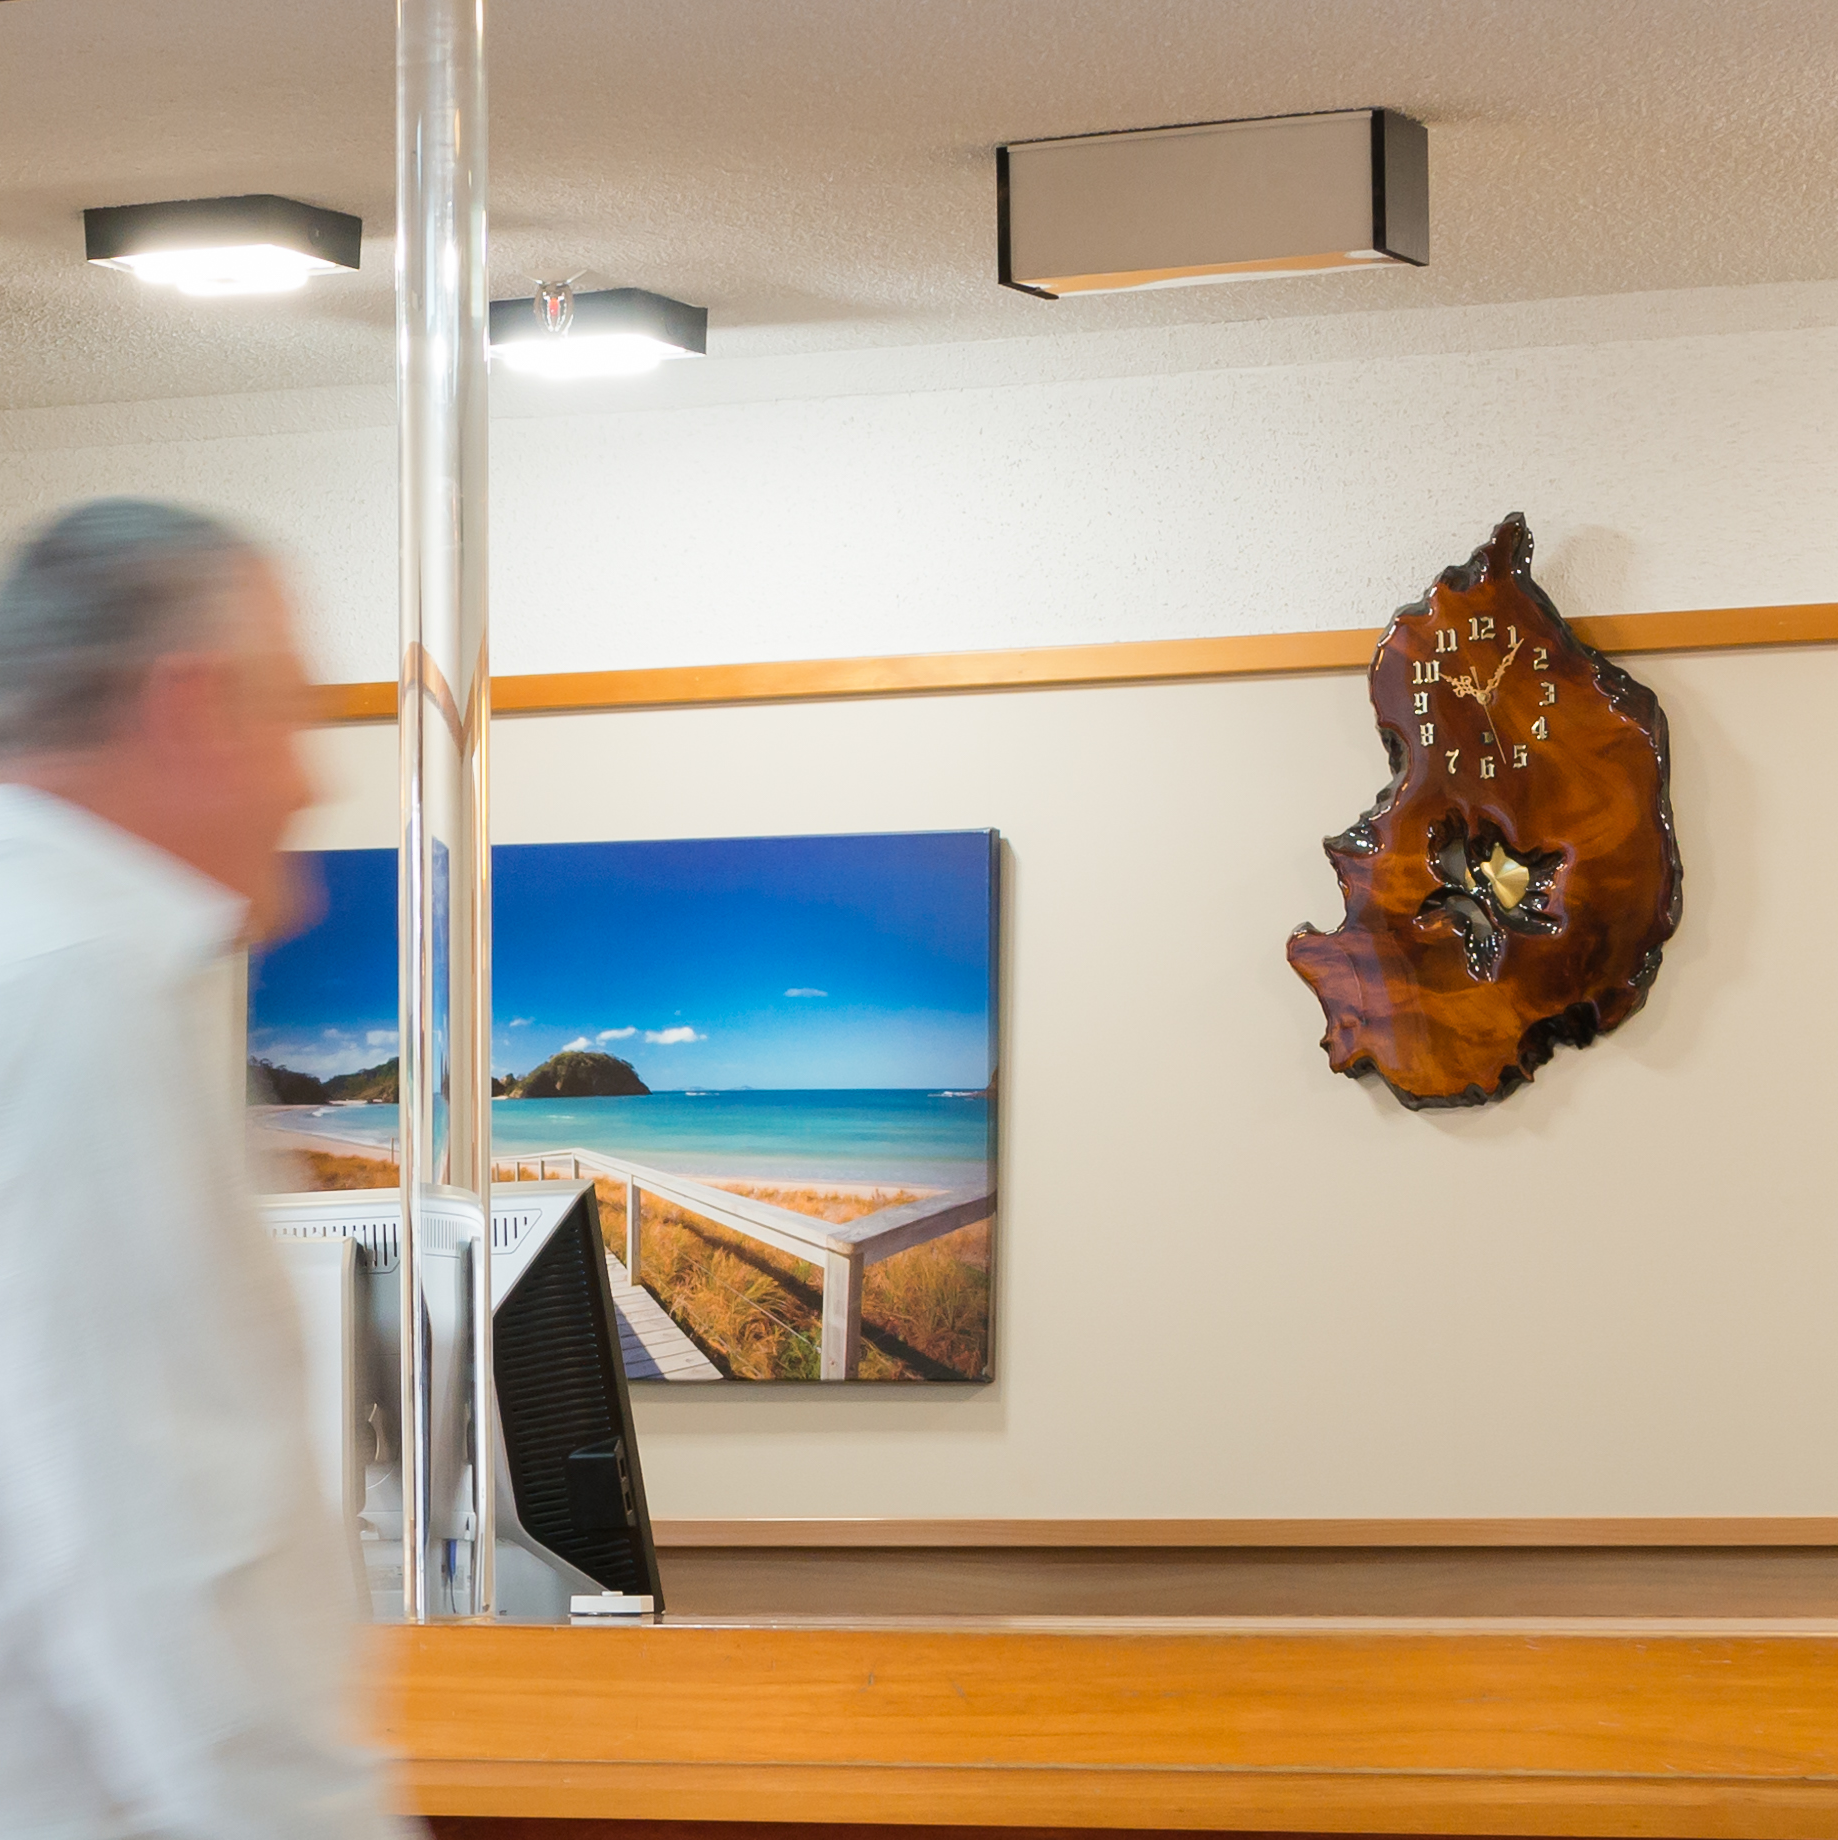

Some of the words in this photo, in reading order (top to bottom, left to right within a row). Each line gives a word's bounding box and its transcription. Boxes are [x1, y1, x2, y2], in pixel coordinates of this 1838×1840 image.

[1434, 628, 1459, 654] 11
[1468, 616, 1496, 641] 12
[1506, 625, 1519, 649] 1
[1533, 646, 1550, 671] 2
[1412, 659, 1441, 685] 10
[1413, 690, 1429, 715] 9
[1538, 681, 1556, 707] 3
[1419, 722, 1435, 747] 8
[1530, 715, 1549, 741] 4
[1444, 748, 1460, 775] 7
[1479, 755, 1495, 780] 6
[1512, 744, 1528, 769] 5
